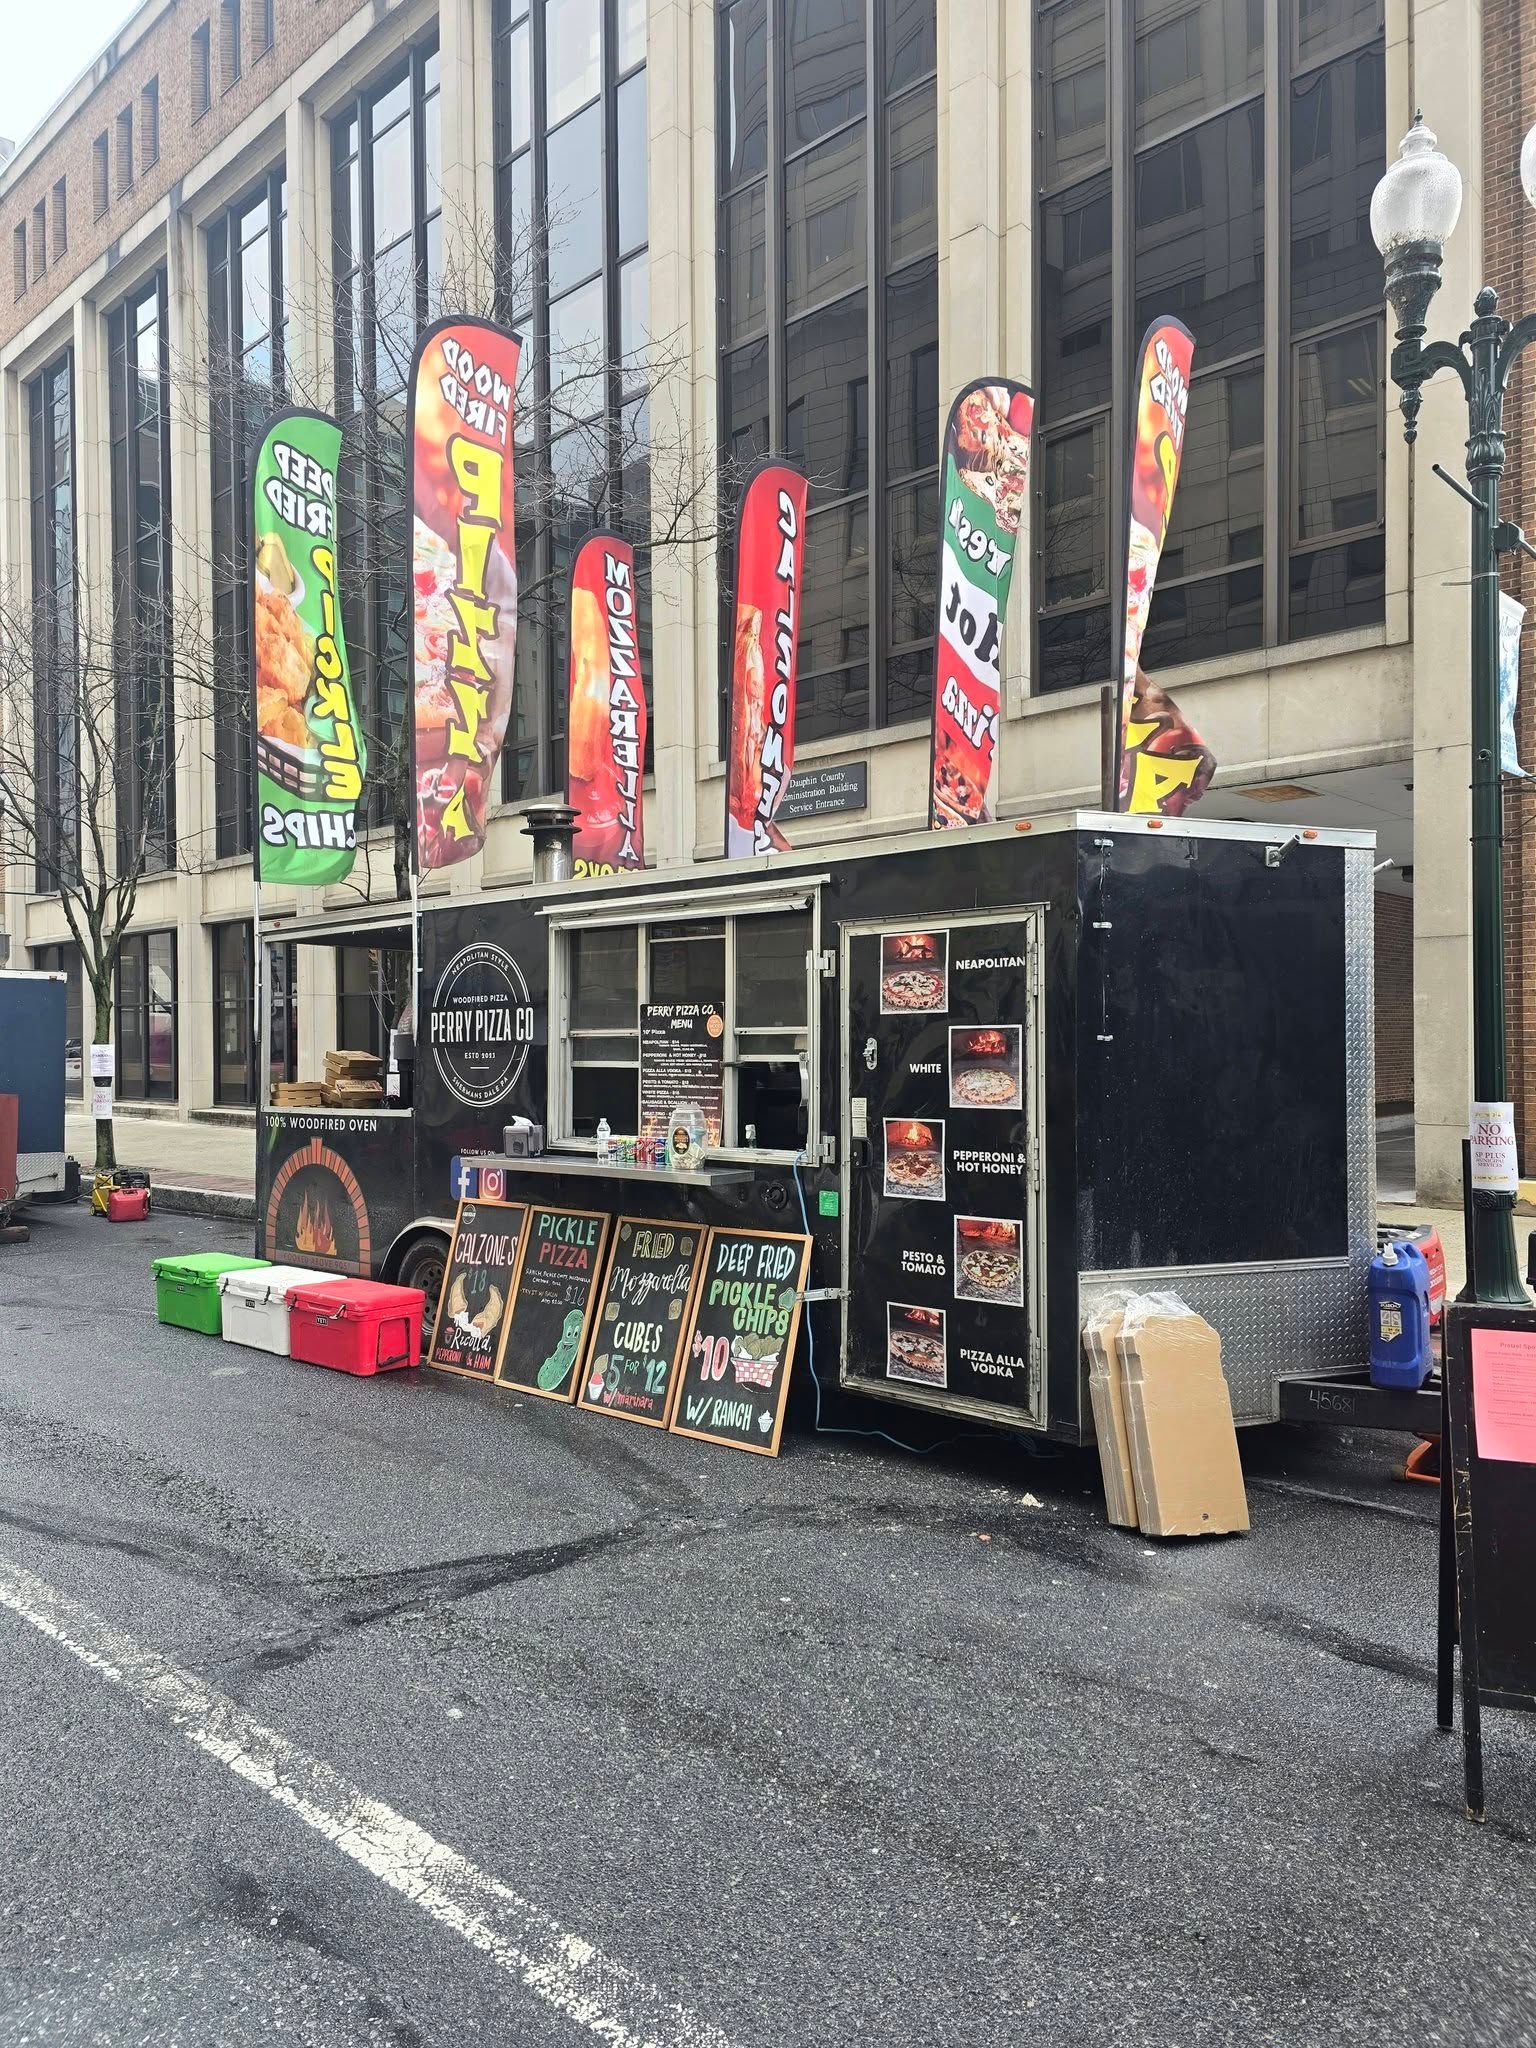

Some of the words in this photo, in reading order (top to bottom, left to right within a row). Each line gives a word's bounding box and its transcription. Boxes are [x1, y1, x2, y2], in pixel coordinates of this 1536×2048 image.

[789, 777, 818, 788] Dauphin
[821, 772, 846, 783] County
[829, 782, 859, 794] Building
[789, 802, 814, 814] Service
[815, 798, 845, 810] Entrance
[451, 951, 490, 976] NEAPOLITAN
[490, 953, 510, 973] STYLE
[955, 956, 1026, 970] NEAPOLITAN
[452, 995, 489, 1005] WOODFIRED
[490, 994, 509, 1002] PIZZA
[647, 1006, 674, 1017] PERRY
[676, 1004, 700, 1016] PIZZA
[431, 1010, 473, 1044] PERRY
[475, 1008, 512, 1043] PIZZA
[516, 1007, 534, 1042] CO
[670, 1019, 693, 1030] MENU
[464, 1052, 480, 1060] ESTD
[909, 1063, 942, 1074] WHITE
[452, 1076, 483, 1099] SHERMANS
[484, 1085, 500, 1099] DALE
[500, 1076, 509, 1088] PA
[265, 1116, 287, 1128] 100%
[290, 1118, 346, 1131] WOODFIRED
[349, 1119, 378, 1132] OVEN
[1478, 1124, 1502, 1136] NO
[1470, 1135, 1514, 1146] PARKING
[953, 1150, 1015, 1163] PEPPERONI
[1016, 1152, 1026, 1164] &
[1485, 1152, 1506, 1160] PLUS
[956, 1162, 980, 1174] HOT
[982, 1164, 1024, 1175] HONEY
[538, 1214, 598, 1246] PICKLE
[454, 1232, 518, 1266] CALZONES
[632, 1230, 676, 1259] FRIED
[538, 1242, 588, 1270] PIZZA
[716, 1243, 754, 1276] DEEP
[756, 1244, 796, 1281] FRIED
[903, 1250, 934, 1264] PESTO
[937, 1254, 945, 1265] &
[901, 1262, 946, 1276] TOMATO
[610, 1264, 691, 1306] Mozzarella
[708, 1278, 777, 1309] PICKLE
[564, 1285, 585, 1306] $16
[317, 1316, 327, 1324] YETI
[733, 1304, 790, 1336] CHIPS
[614, 1322, 663, 1354] CUBES
[466, 1352, 473, 1366] &
[474, 1354, 492, 1370] HAM
[692, 1330, 730, 1382] $10
[960, 1348, 994, 1364] PIZZA
[996, 1354, 1025, 1369] ALLA
[606, 1354, 624, 1391] 5
[624, 1359, 640, 1375] FOR
[643, 1354, 667, 1394] $12
[970, 1361, 1014, 1379] VODKA
[618, 1392, 654, 1410] marinara
[686, 1394, 713, 1426] W/
[710, 1399, 752, 1432] RANCH
